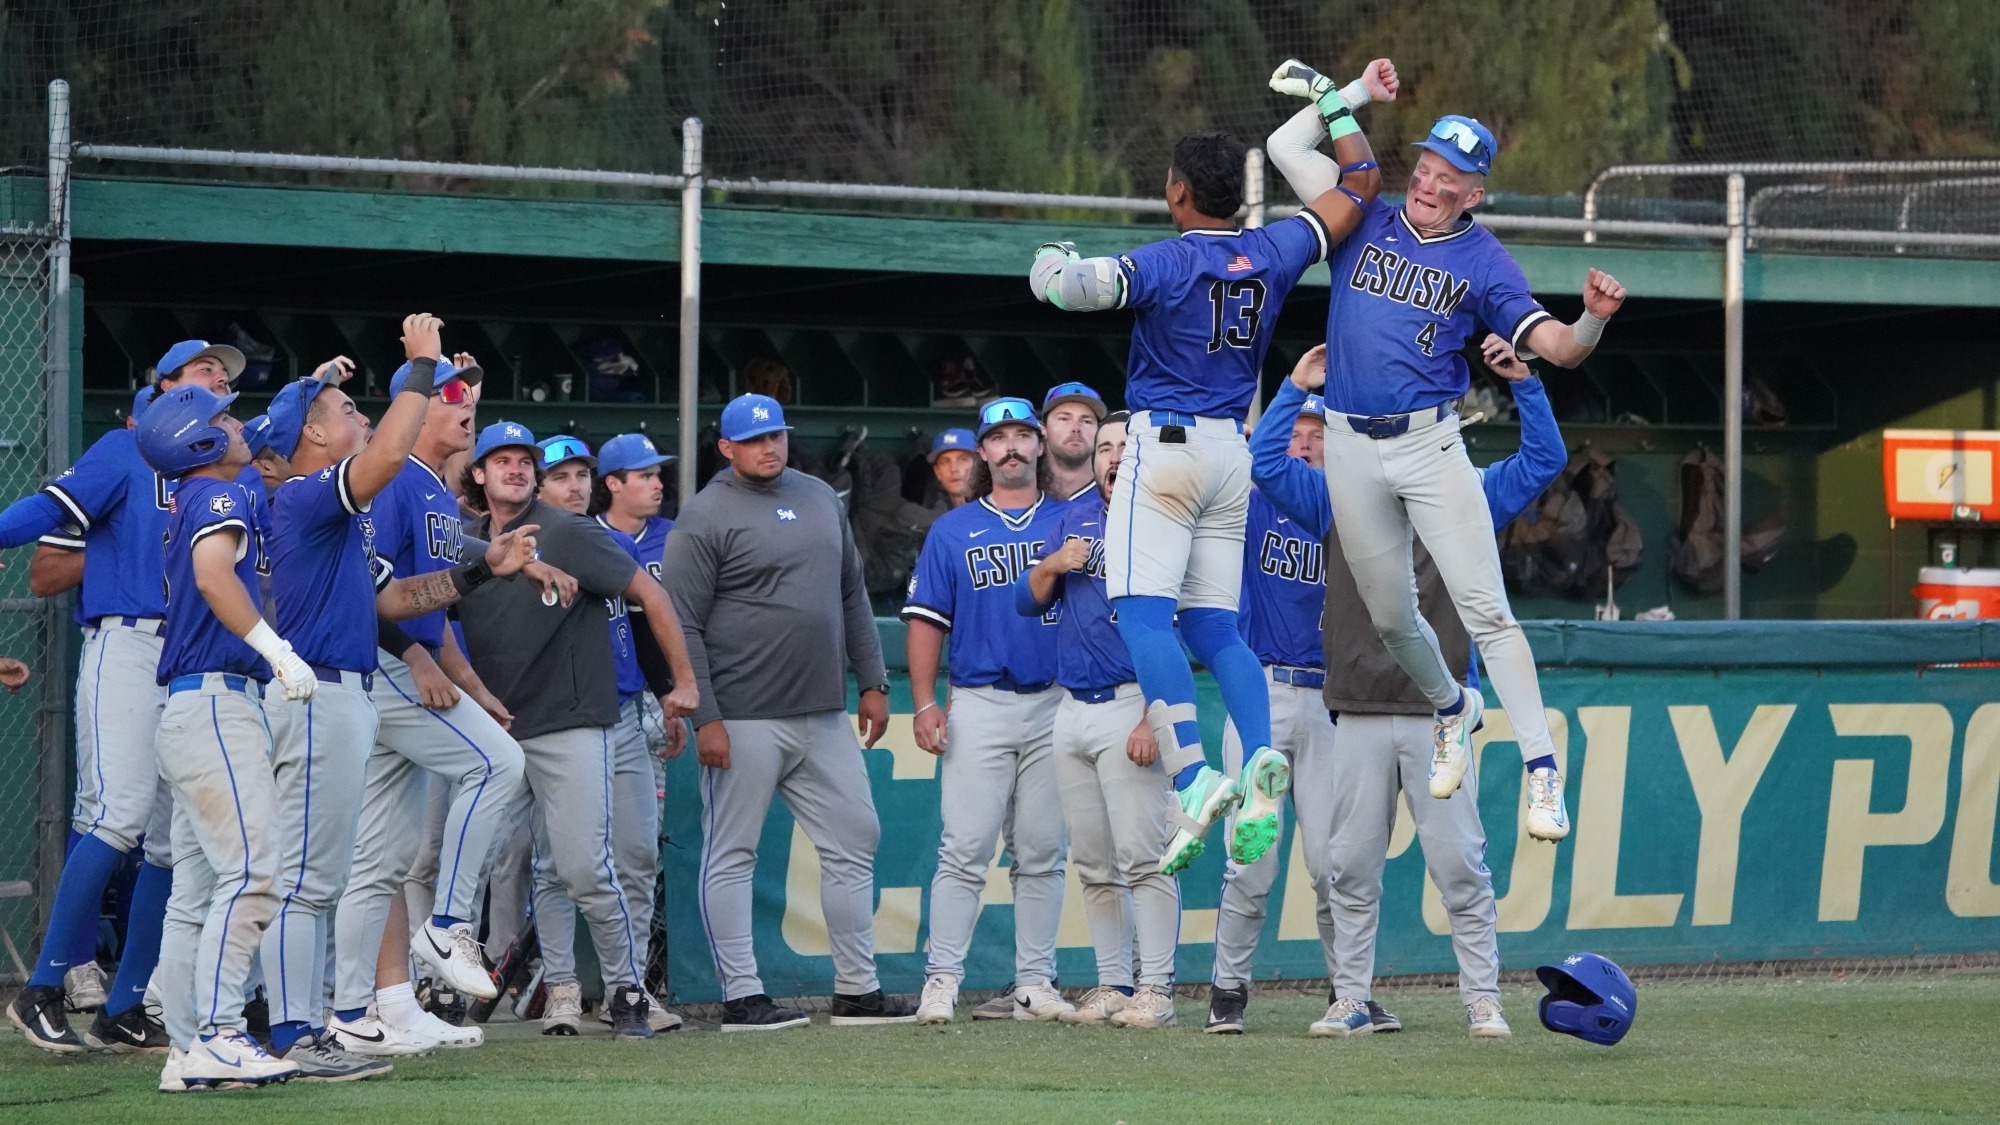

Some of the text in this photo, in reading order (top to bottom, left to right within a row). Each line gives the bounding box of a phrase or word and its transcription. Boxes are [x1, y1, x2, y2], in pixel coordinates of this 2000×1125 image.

[1350, 243, 1469, 320] CSUSM
[1207, 278, 1267, 354] 13
[1415, 321, 1437, 357] 4
[752, 406, 769, 420] SM
[505, 425, 522, 438] SM
[776, 508, 797, 521] SM
[1260, 530, 1326, 586] CSU
